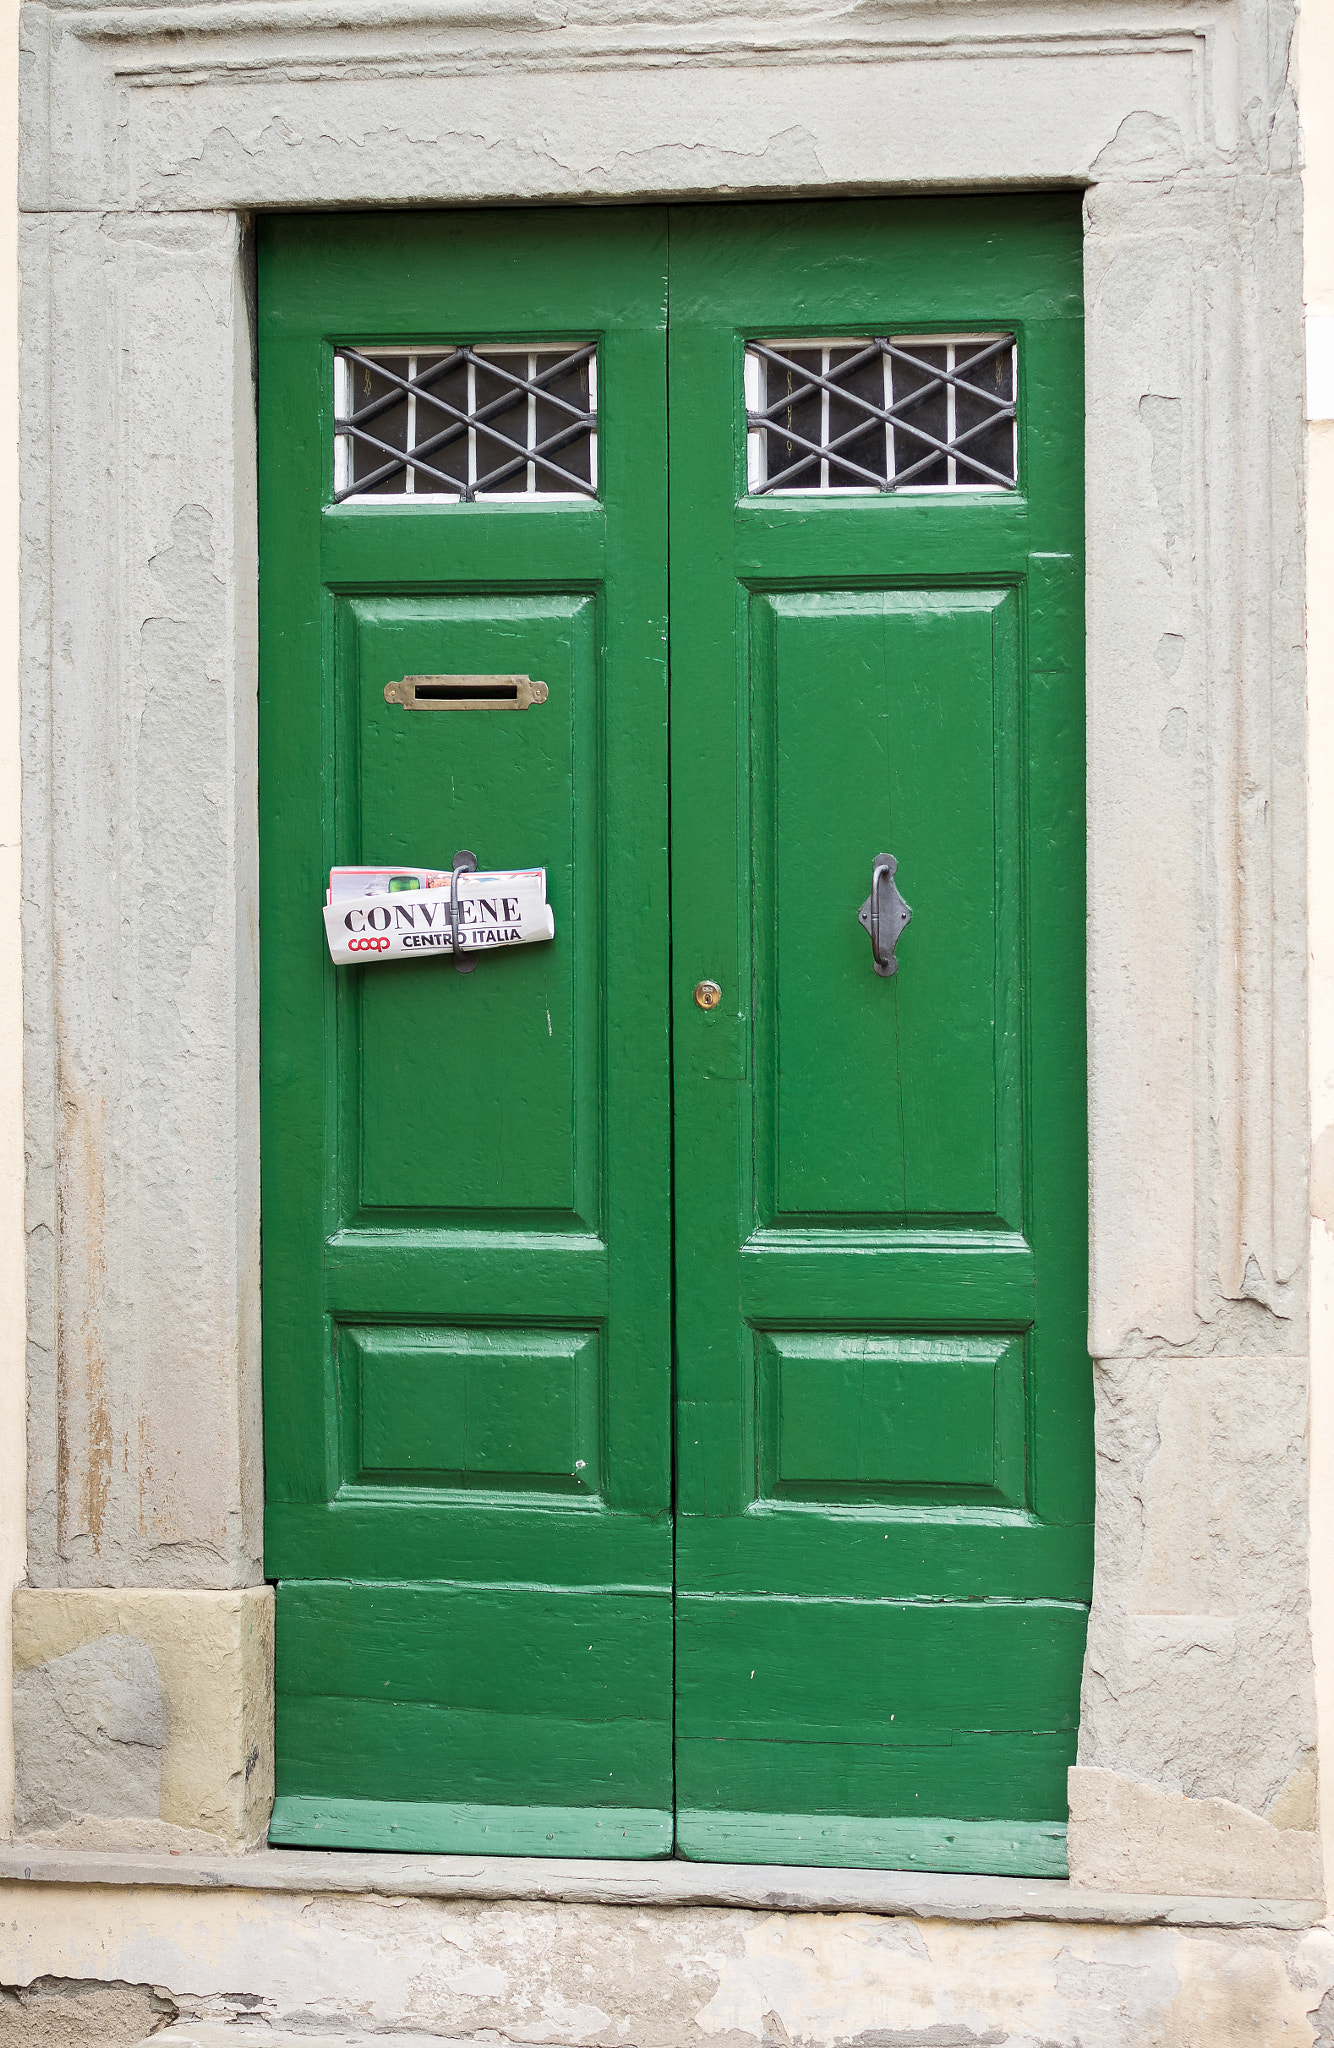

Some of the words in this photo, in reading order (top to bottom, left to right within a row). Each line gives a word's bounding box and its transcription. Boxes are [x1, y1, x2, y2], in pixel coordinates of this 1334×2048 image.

[344, 897, 522, 933] CONVIENE
[402, 932, 468, 948] CENTRO
[473, 928, 522, 944] ITALIA
